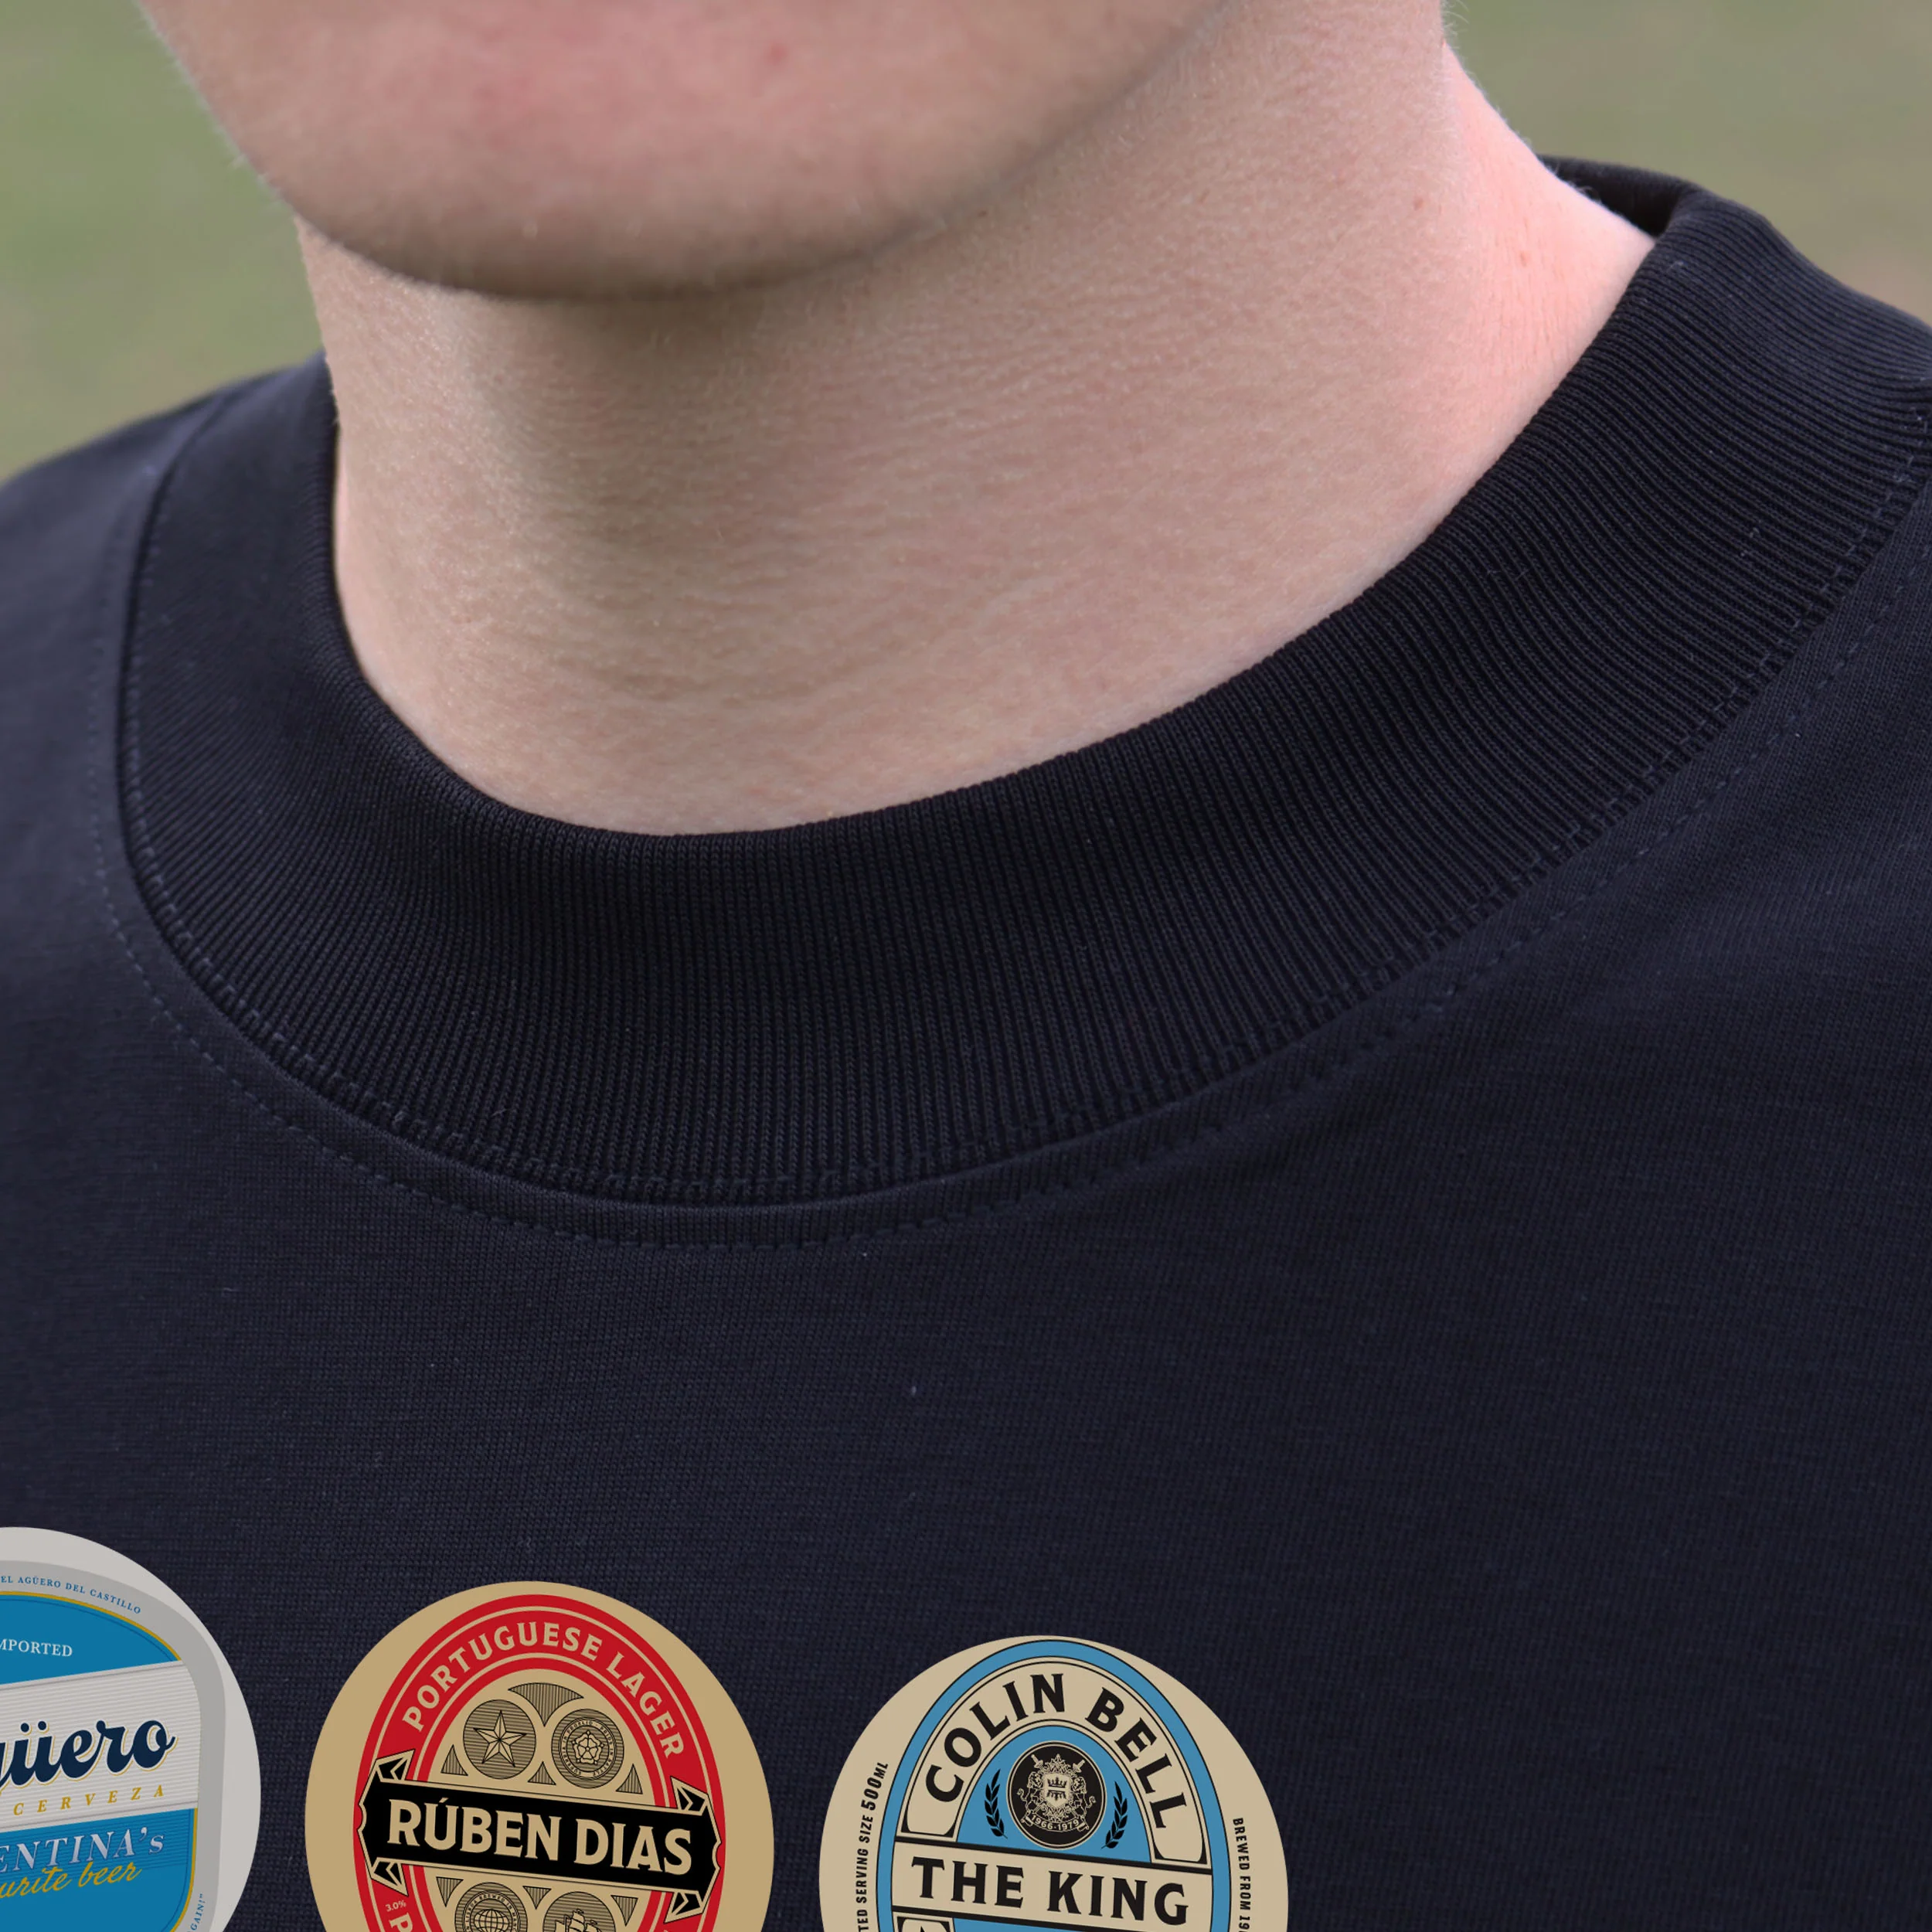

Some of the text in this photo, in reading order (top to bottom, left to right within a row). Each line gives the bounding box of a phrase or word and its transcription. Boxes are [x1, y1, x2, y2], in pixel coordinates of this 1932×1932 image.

[18, 1575, 61, 1588] AGÜERO
[66, 1582, 85, 1594] DEL
[90, 1589, 141, 1614] CASTILLO
[402, 1621, 684, 1759] PORTUGUESE LAGER
[0, 1720, 177, 1790] üero
[926, 1673, 1187, 1829] COLIN BELL
[13, 1784, 164, 1815] CERVEZA
[861, 1762, 888, 1811] 500ML
[387, 1797, 692, 1876] RÚBEN DIAS
[859, 1815, 873, 1843] SIZE
[78, 1861, 143, 1887] beer
[855, 1849, 869, 1903] SERVING
[911, 1856, 1189, 1926] THE KING
[1233, 1818, 1251, 1932] BREWED FROM 19
[187, 1893, 206, 1932] GAIN!"
[386, 1900, 406, 1912] 3.0%
